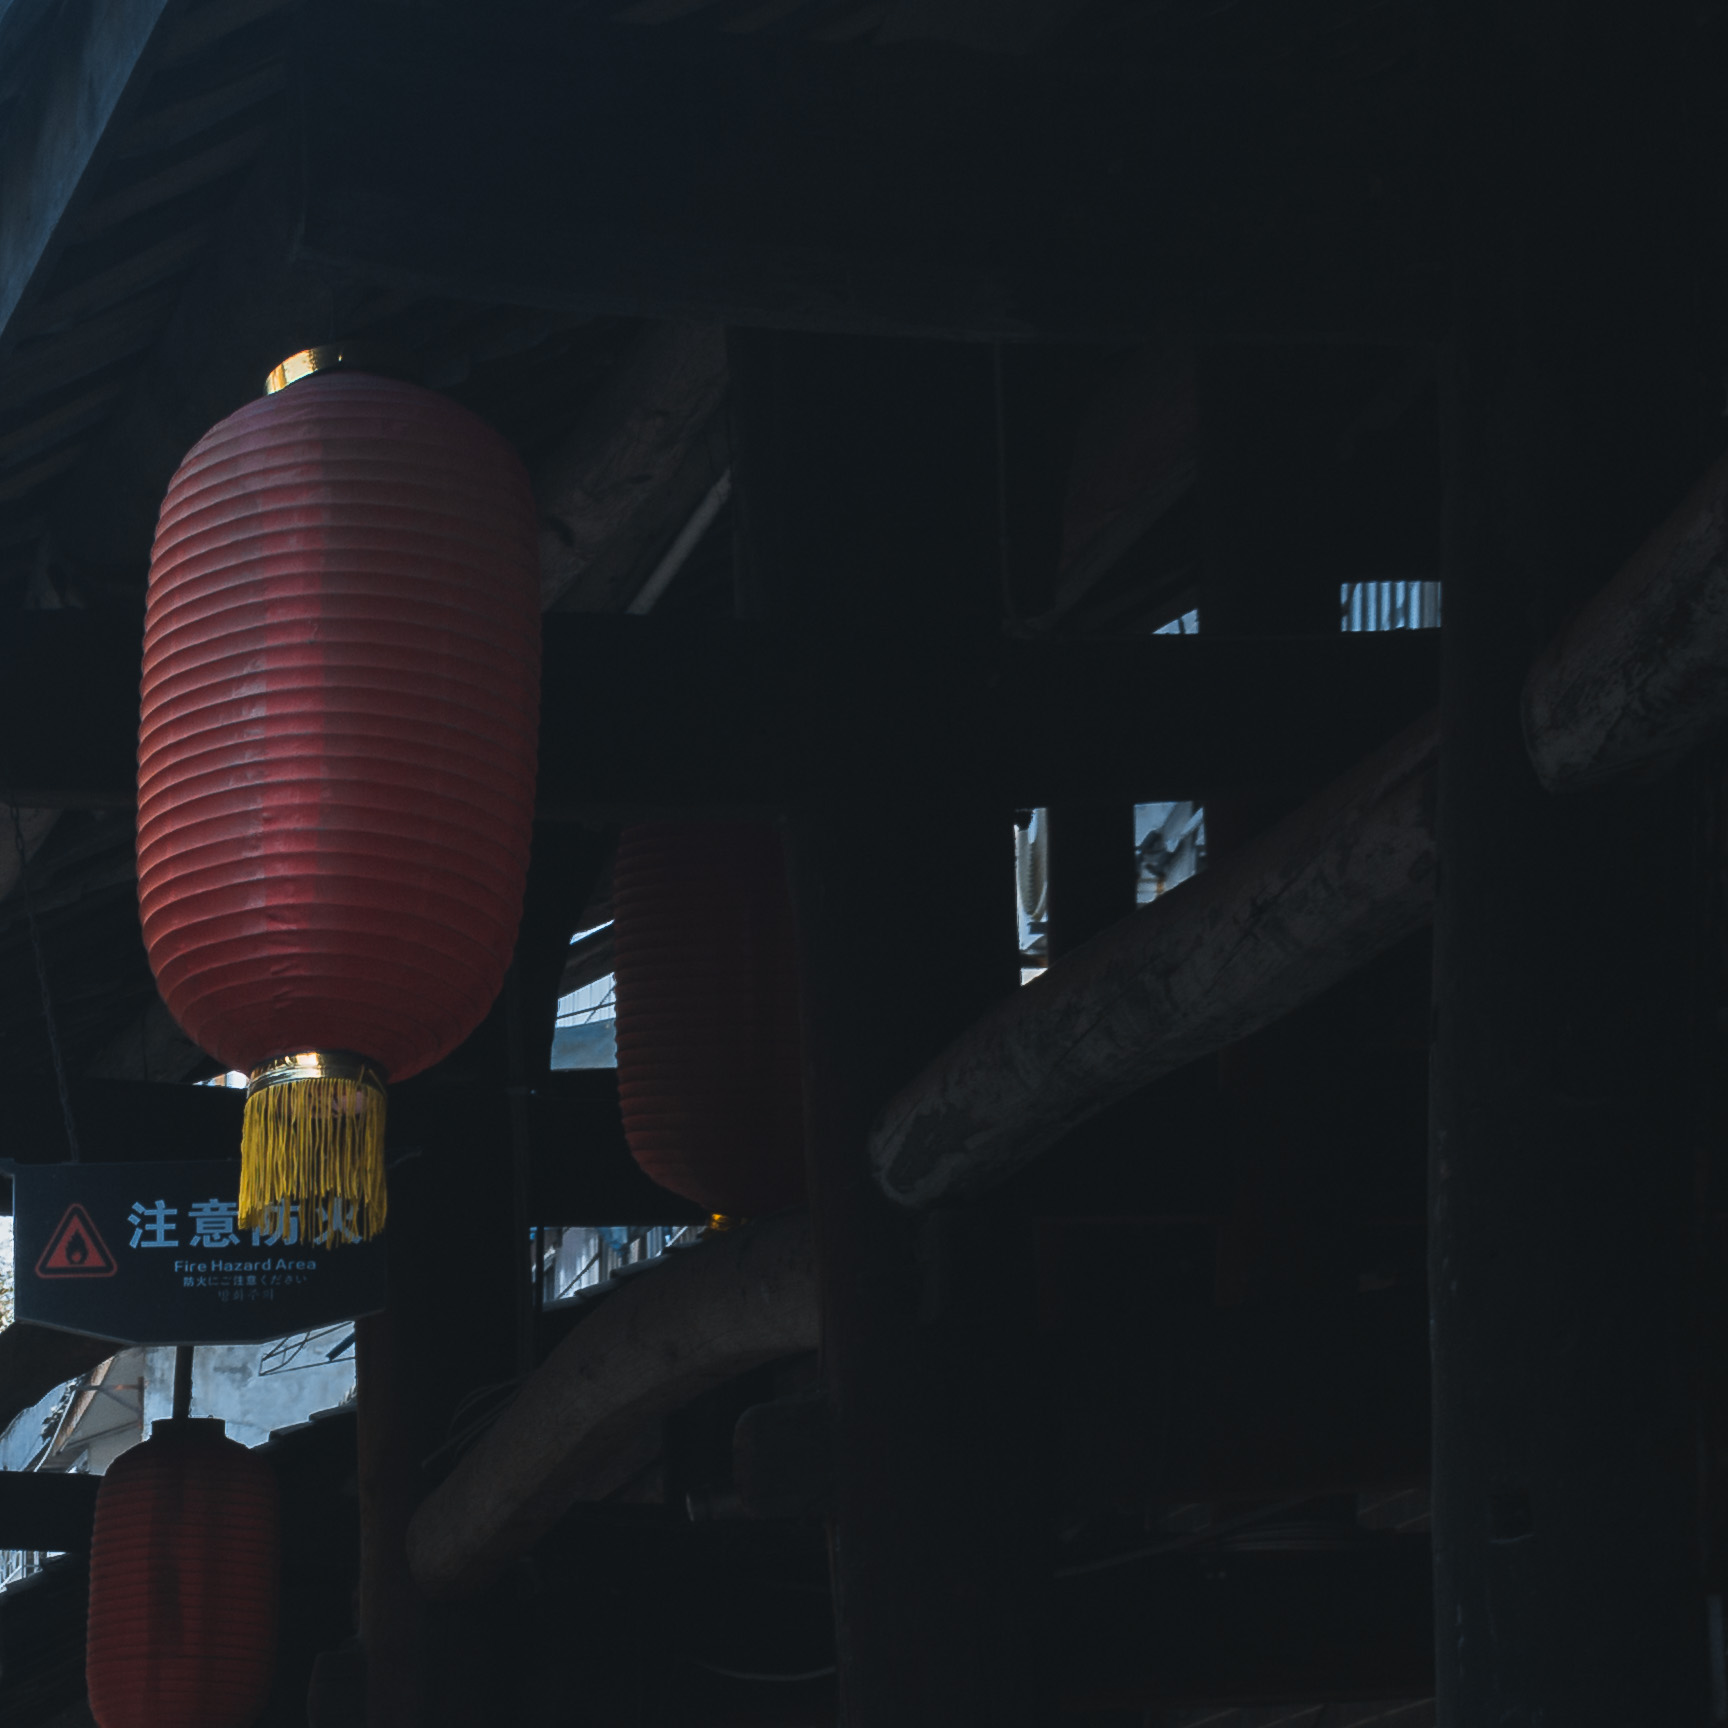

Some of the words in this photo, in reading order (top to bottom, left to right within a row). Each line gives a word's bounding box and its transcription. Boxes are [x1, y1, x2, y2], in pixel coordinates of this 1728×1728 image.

[174, 1260, 207, 1273] Fire
[211, 1258, 271, 1272] Hazard
[275, 1257, 317, 1271] Area
